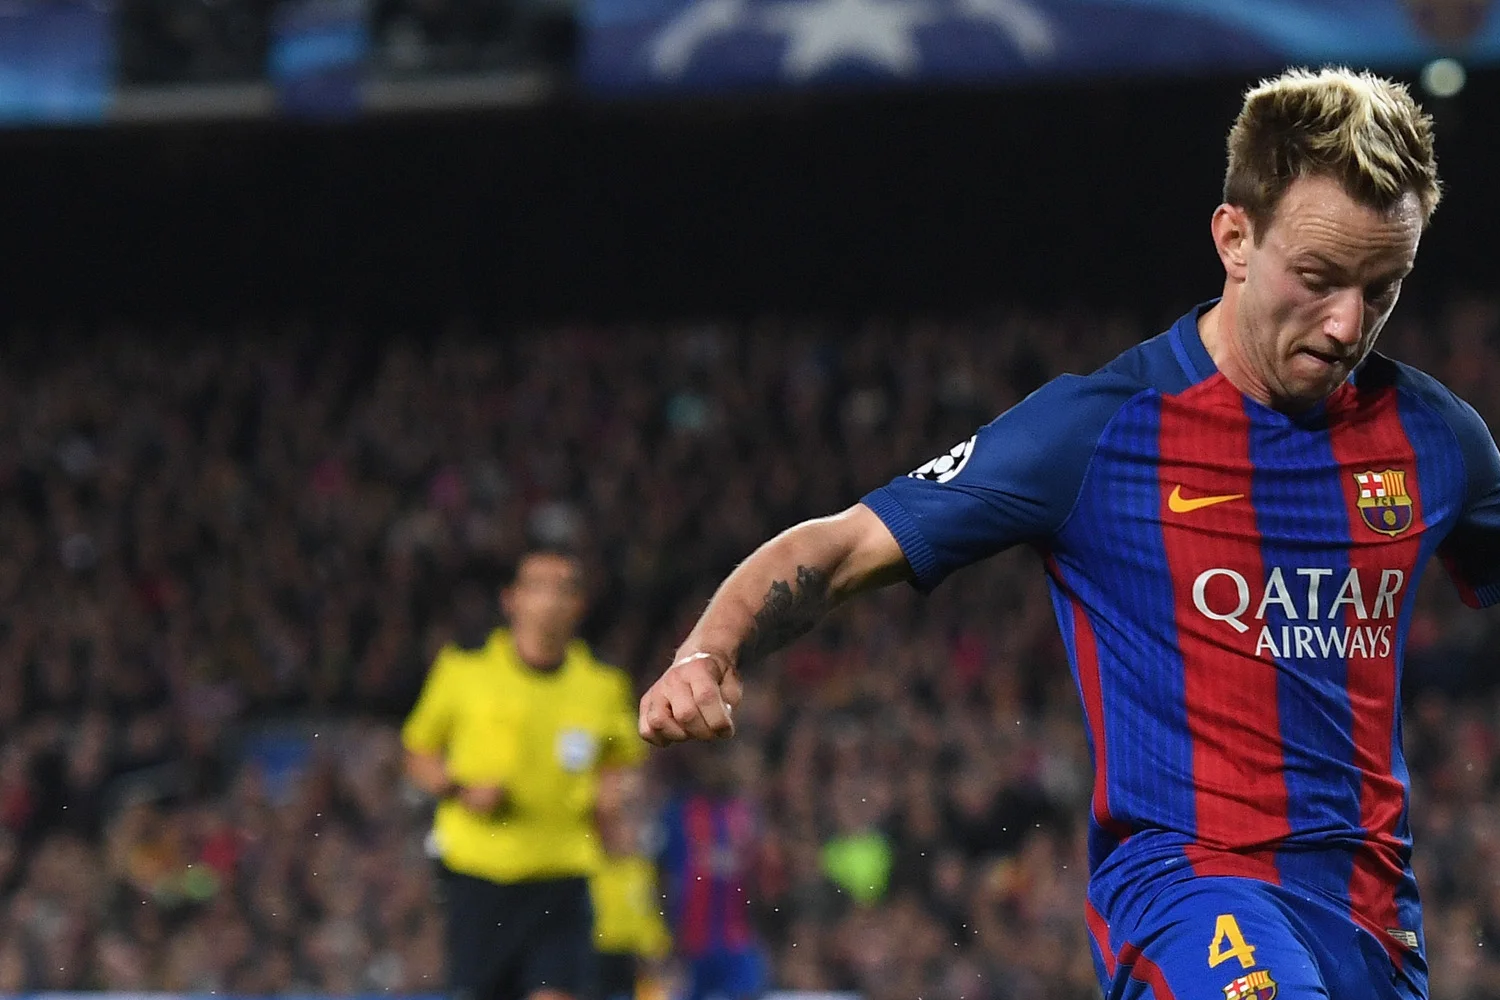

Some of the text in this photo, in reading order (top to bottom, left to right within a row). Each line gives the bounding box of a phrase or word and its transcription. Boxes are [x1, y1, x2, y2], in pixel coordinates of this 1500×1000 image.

[1192, 567, 1404, 634] QATAR
[1255, 625, 1392, 659] AIRWAYS
[1208, 914, 1256, 969] 4
